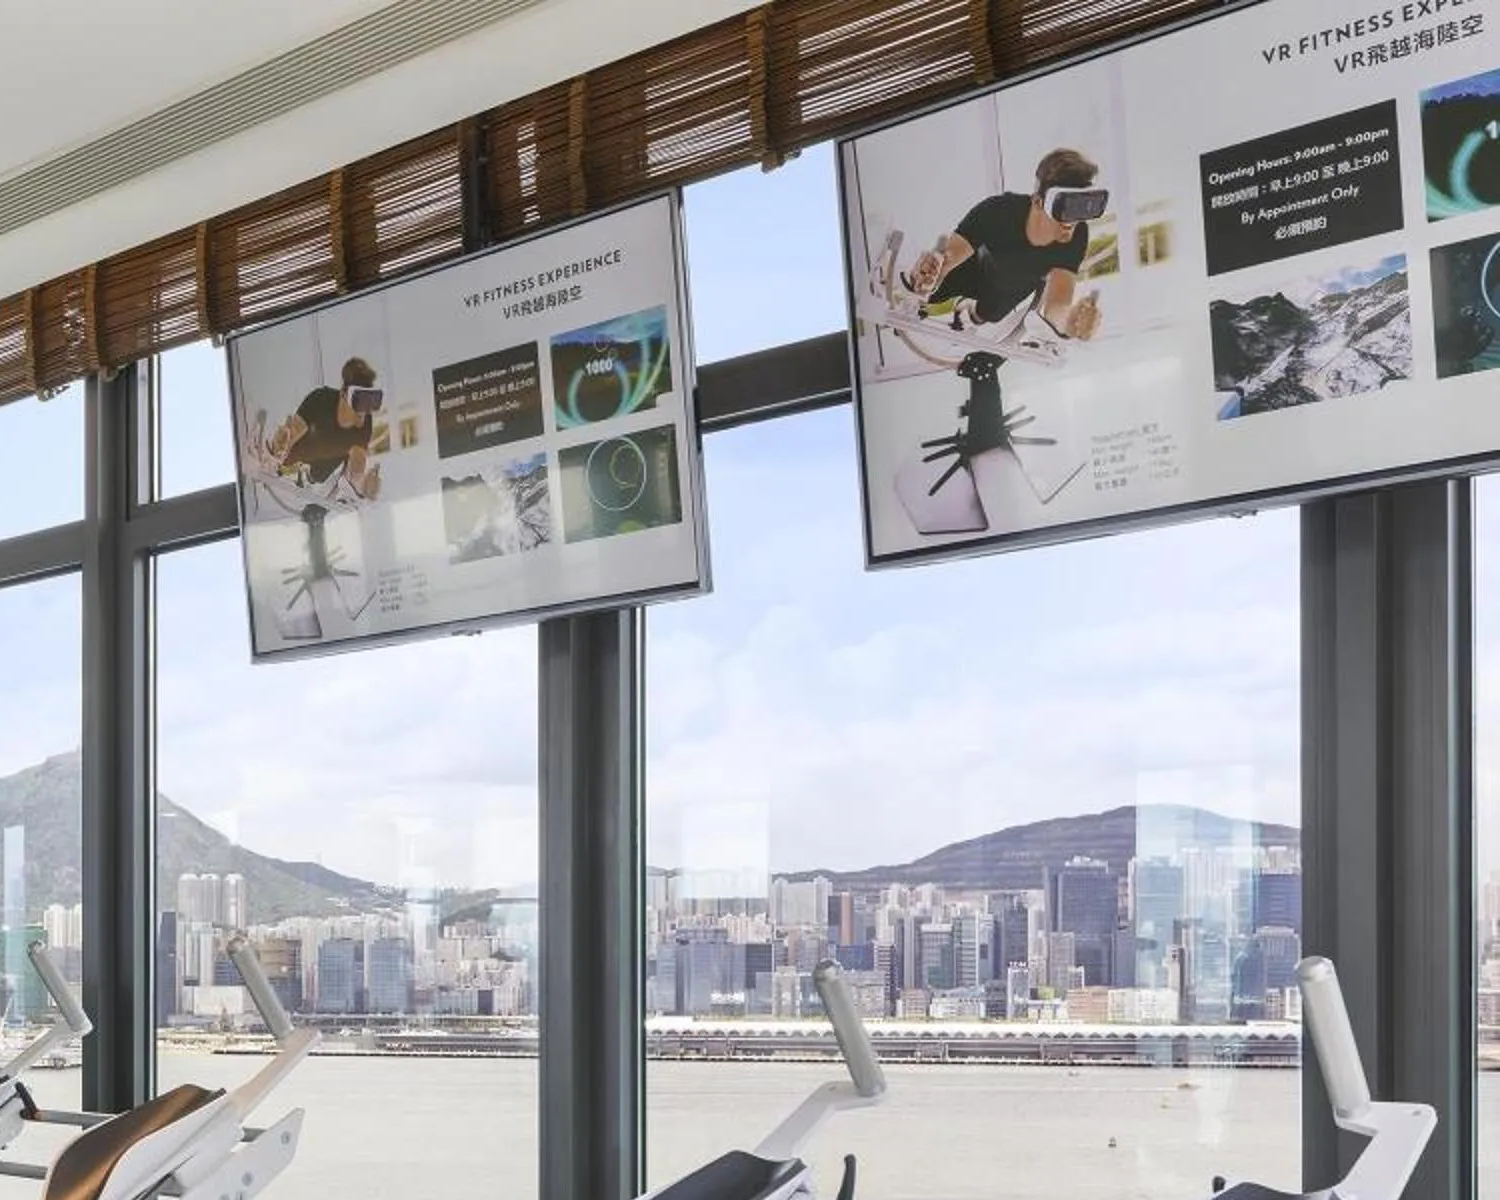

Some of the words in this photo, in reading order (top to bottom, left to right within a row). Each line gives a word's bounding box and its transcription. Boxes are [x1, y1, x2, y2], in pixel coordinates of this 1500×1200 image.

[1262, 44, 1291, 64] VR
[1299, 10, 1394, 54] FITNESS
[1209, 167, 1255, 185] Opening
[1241, 211, 1255, 224] By
[1257, 193, 1329, 220] Appointment
[1331, 184, 1361, 200] Only
[463, 294, 481, 308] VR
[483, 276, 535, 303] FITNESS
[538, 249, 621, 287] EXPERIENCE
